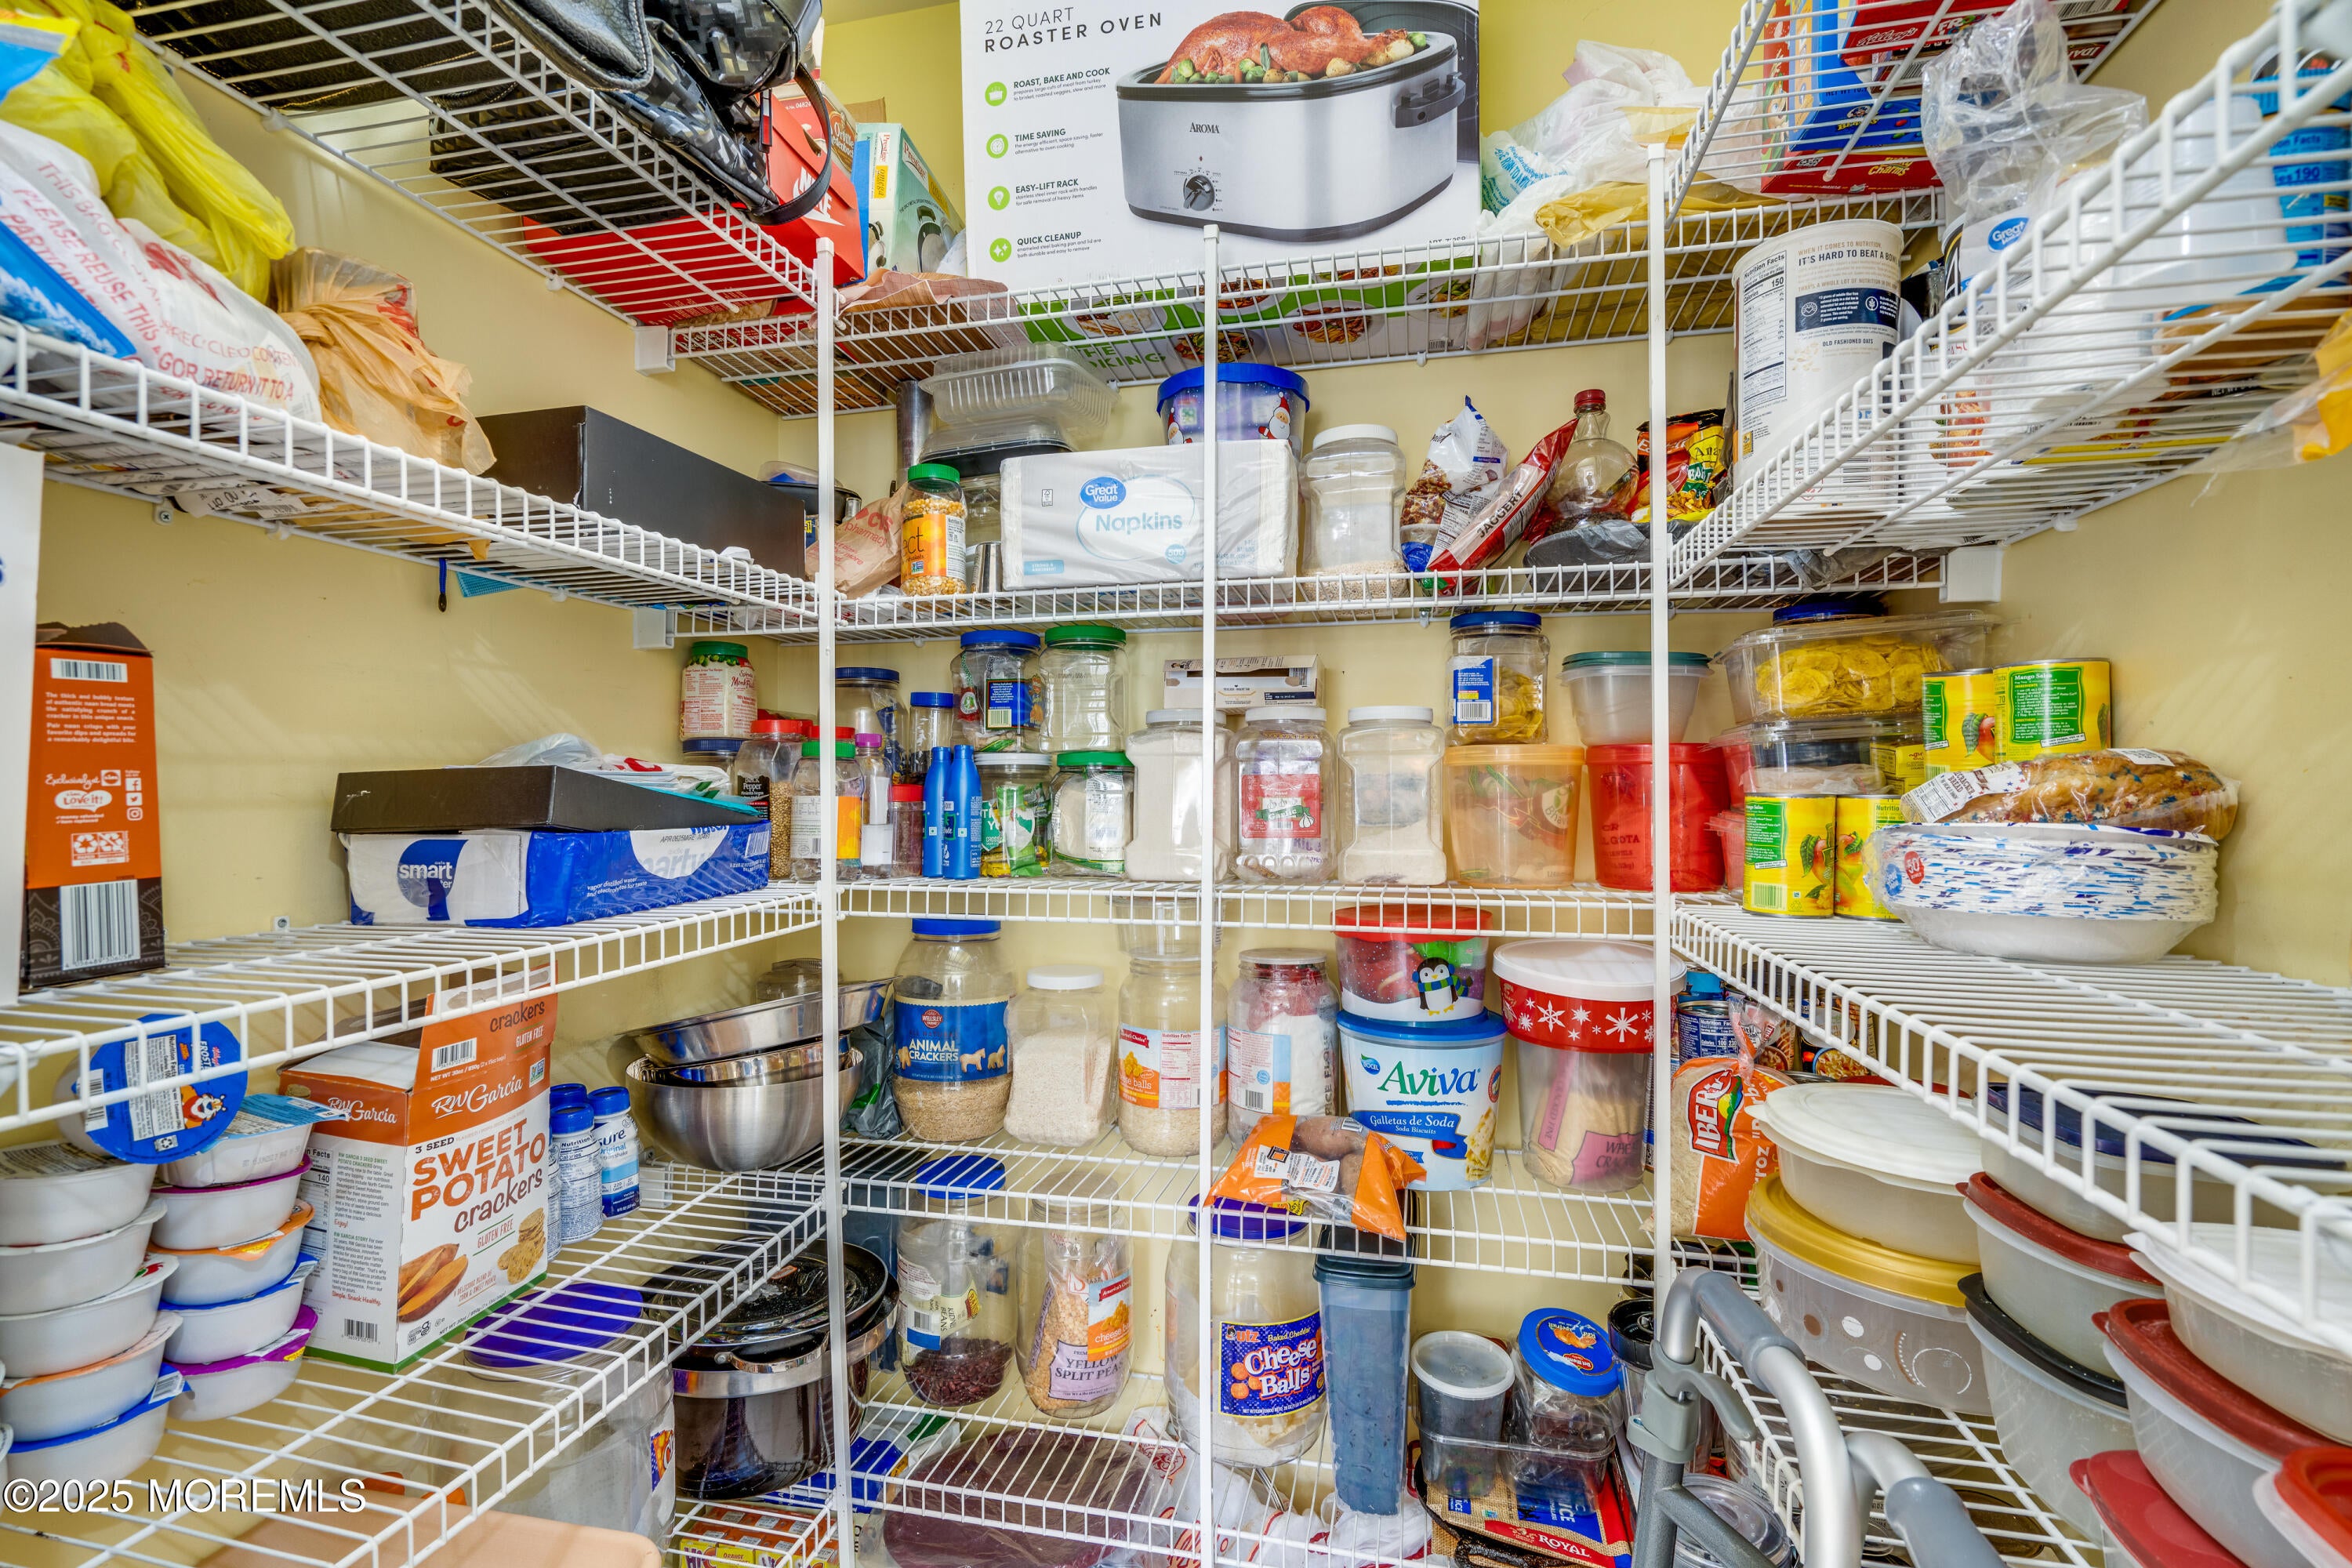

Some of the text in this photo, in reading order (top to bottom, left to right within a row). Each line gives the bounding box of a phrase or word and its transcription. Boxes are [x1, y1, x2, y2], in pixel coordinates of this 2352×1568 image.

[985, 7, 1074, 34] 22 QUART
[985, 13, 1161, 53] ROASTER OVEN
[1014, 67, 1110, 89] ROAST, BAKE AND COOK
[1189, 122, 1220, 134] AROMA
[1015, 129, 1066, 142] TIME SAVING
[1868, 165, 1911, 176] Charms
[2295, 167, 2321, 180] 190
[1015, 178, 1079, 193] EASY-LIFT RACK
[1017, 231, 1082, 245] QUICK CLEANUP
[1992, 221, 2025, 241] Great
[1824, 242, 1845, 251] COMES
[13, 187, 158, 343] PLEASE REUSE THIS
[1798, 249, 1885, 267] IT'S HARD TO BEAT A
[1744, 254, 1785, 279] Nutrition Facts
[1771, 277, 1784, 288] 150
[1821, 279, 1839, 288] WHOLE
[1743, 290, 1759, 303] Calories
[205, 368, 284, 400] RETURN IT TO
[1085, 484, 1119, 497] Great
[1093, 494, 1119, 503] Value
[1476, 490, 1523, 539] JAGGERY
[1096, 512, 1183, 535] Napkins
[743, 783, 761, 792] Pepper
[1948, 775, 1964, 793] BREAD
[64, 795, 89, 805] Love
[398, 861, 452, 880] smart
[1907, 857, 1920, 875] 50
[587, 881, 602, 891] vapor
[604, 879, 622, 887] distilled
[597, 885, 626, 895] electrolytes
[489, 1000, 545, 1033] crackers
[516, 1025, 544, 1048] GLUTEN FREE
[909, 1039, 959, 1052] ANIMAL
[909, 1051, 959, 1062] CRACKERS
[468, 1064, 480, 1073] 850g
[1133, 1079, 1152, 1090] balls
[1377, 1061, 1478, 1096] Aviva
[1370, 1115, 1455, 1127] Galletas de Soda
[426, 1137, 454, 1151] SEED
[561, 1136, 587, 1147] Nutrition
[313, 1149, 330, 1159] Facts
[412, 1118, 527, 1186] SWEET
[318, 1174, 329, 1183] 140
[412, 1133, 546, 1221] POTATO
[454, 1168, 542, 1232] crackers
[477, 1218, 513, 1249] GLUTEN FREE
[347, 1294, 361, 1303] Snack
[1095, 1327, 1121, 1343] cheese
[1236, 1330, 1259, 1343] utz
[1268, 1327, 1311, 1342] Baked Cheddar
[1065, 1355, 1118, 1369] YELLOW
[1244, 1338, 1317, 1375] Cheese
[1055, 1367, 1095, 1378] SPLIT
[1259, 1366, 1310, 1397] Balls
[1537, 1534, 1591, 1559] ROYAL
